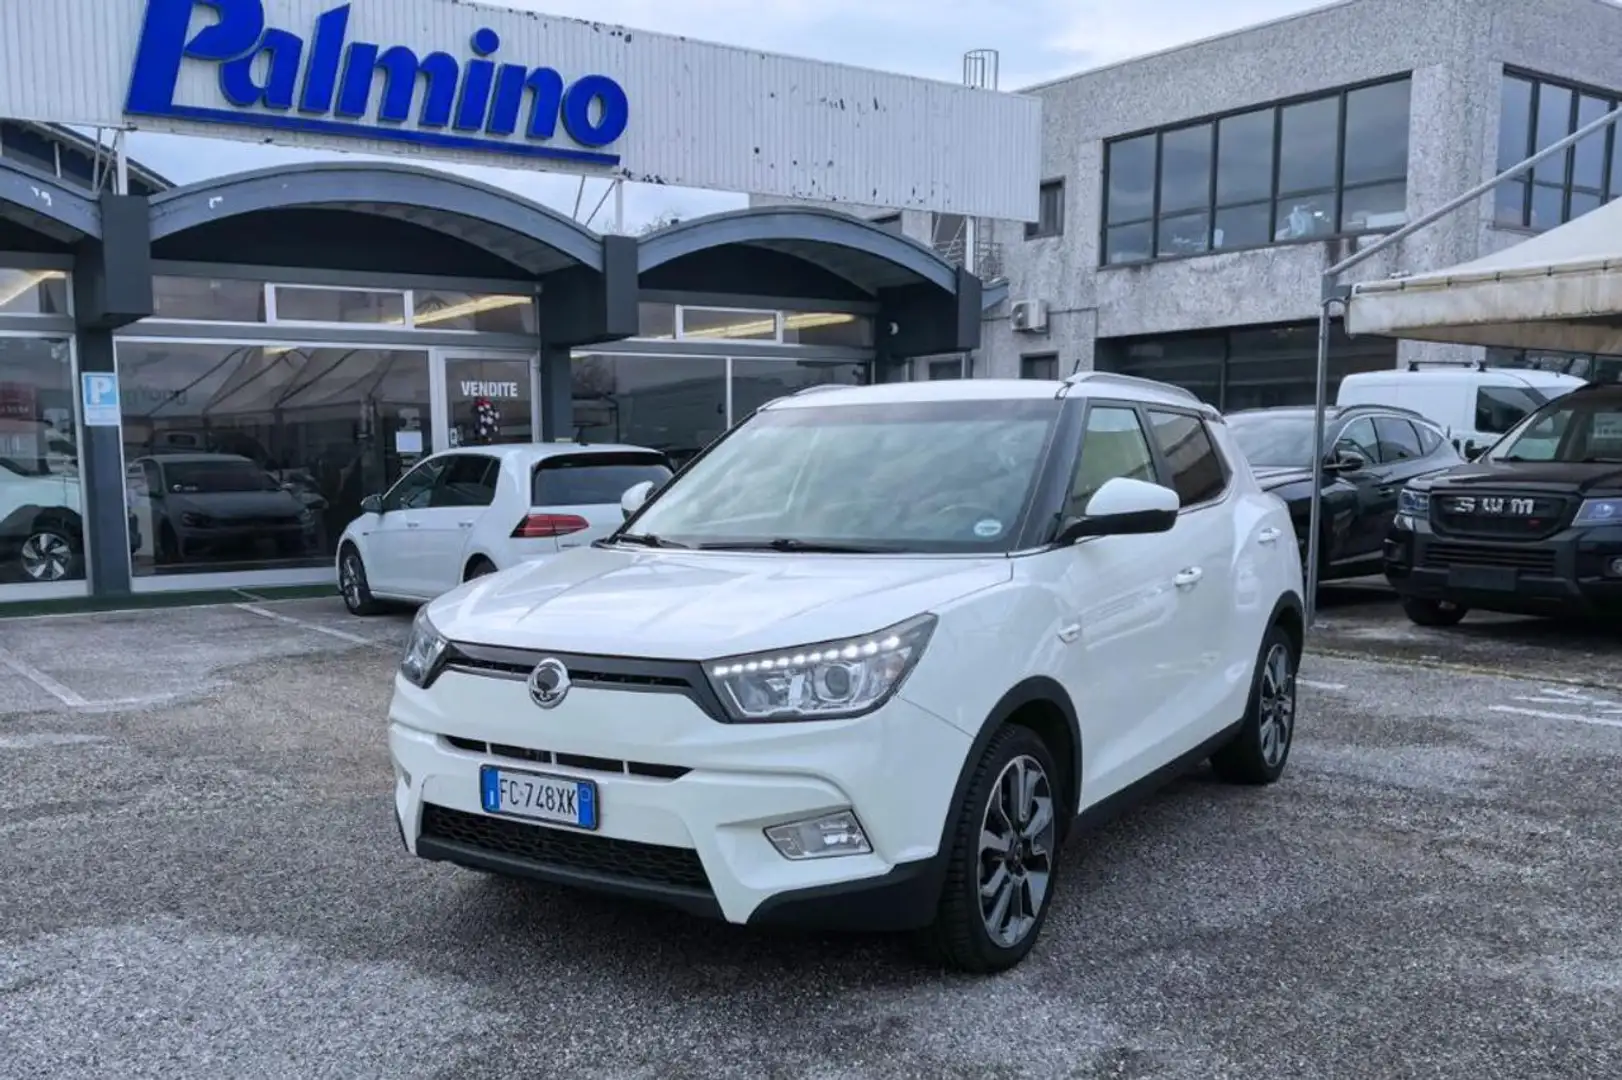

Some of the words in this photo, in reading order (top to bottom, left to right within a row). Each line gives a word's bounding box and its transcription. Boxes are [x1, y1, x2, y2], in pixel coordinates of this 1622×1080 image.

[124, 0, 628, 147] Palmino
[88, 377, 112, 404] P
[461, 381, 518, 397] VENDITE
